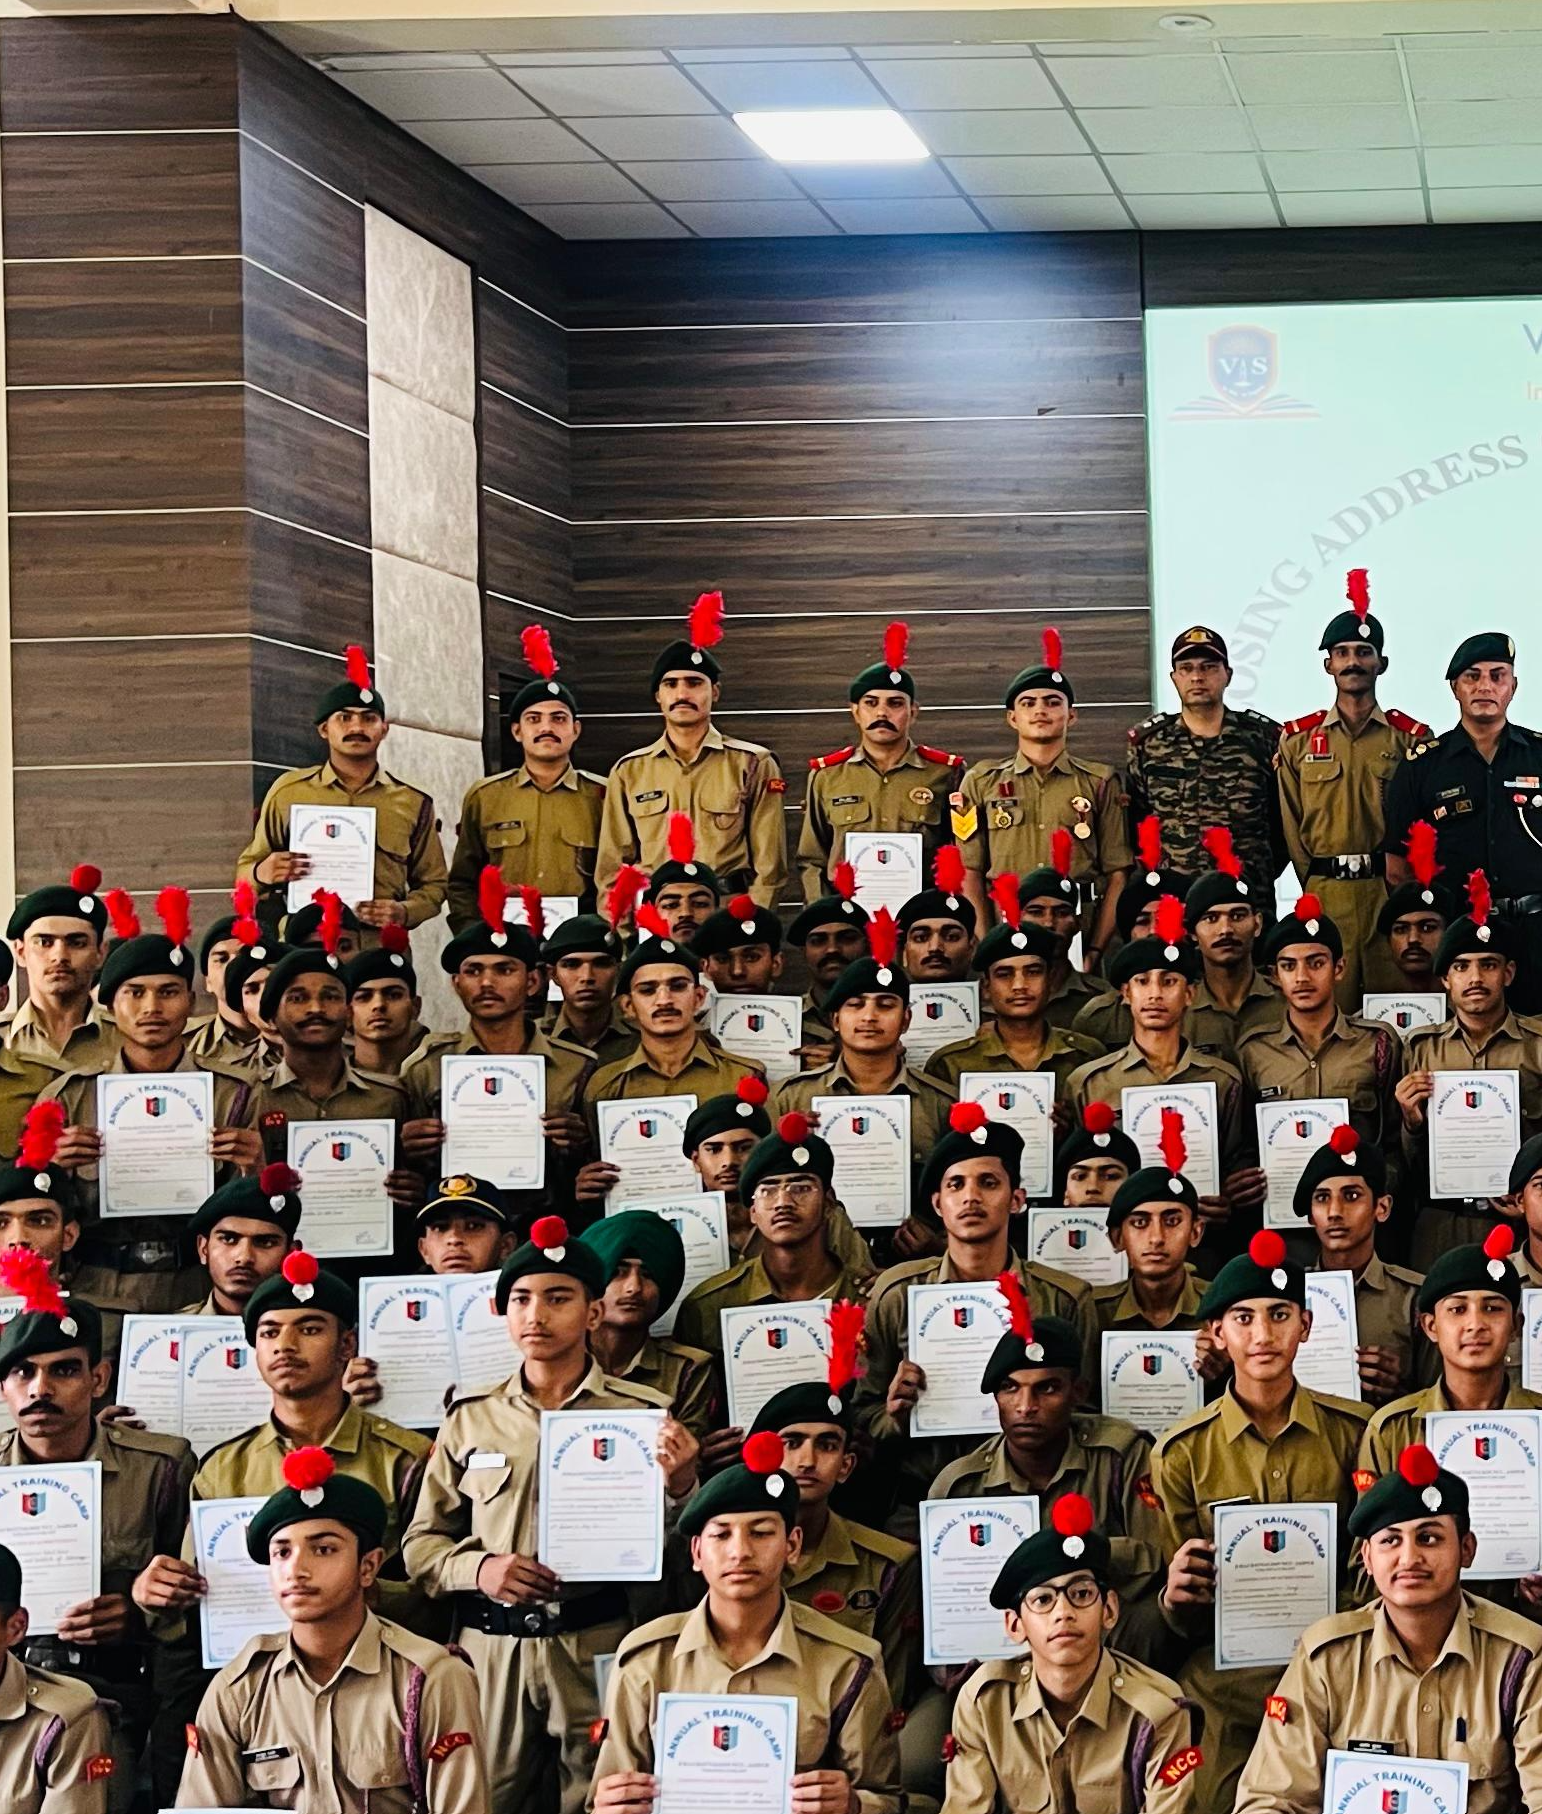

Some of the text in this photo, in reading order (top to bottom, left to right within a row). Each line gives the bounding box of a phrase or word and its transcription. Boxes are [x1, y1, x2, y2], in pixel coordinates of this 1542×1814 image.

[1228, 558, 1313, 707] OSING
[1310, 435, 1528, 567] ADDRESS
[661, 1206, 701, 1217] RAINING
[584, 1423, 637, 1439] TRAINING
[1438, 1422, 1536, 1467] NNUAL TRAINING CAMP
[12, 1478, 70, 1493] TRAINING
[960, 1510, 1012, 1525] TRAINING
[1225, 1516, 1325, 1563] ANNUAL TRAINING CAMP
[667, 1709, 783, 1761] ANNUAL TRAINING CAMP
[1166, 1752, 1197, 1780] NCC
[1336, 1771, 1433, 1814] NNUAL TRAINING
